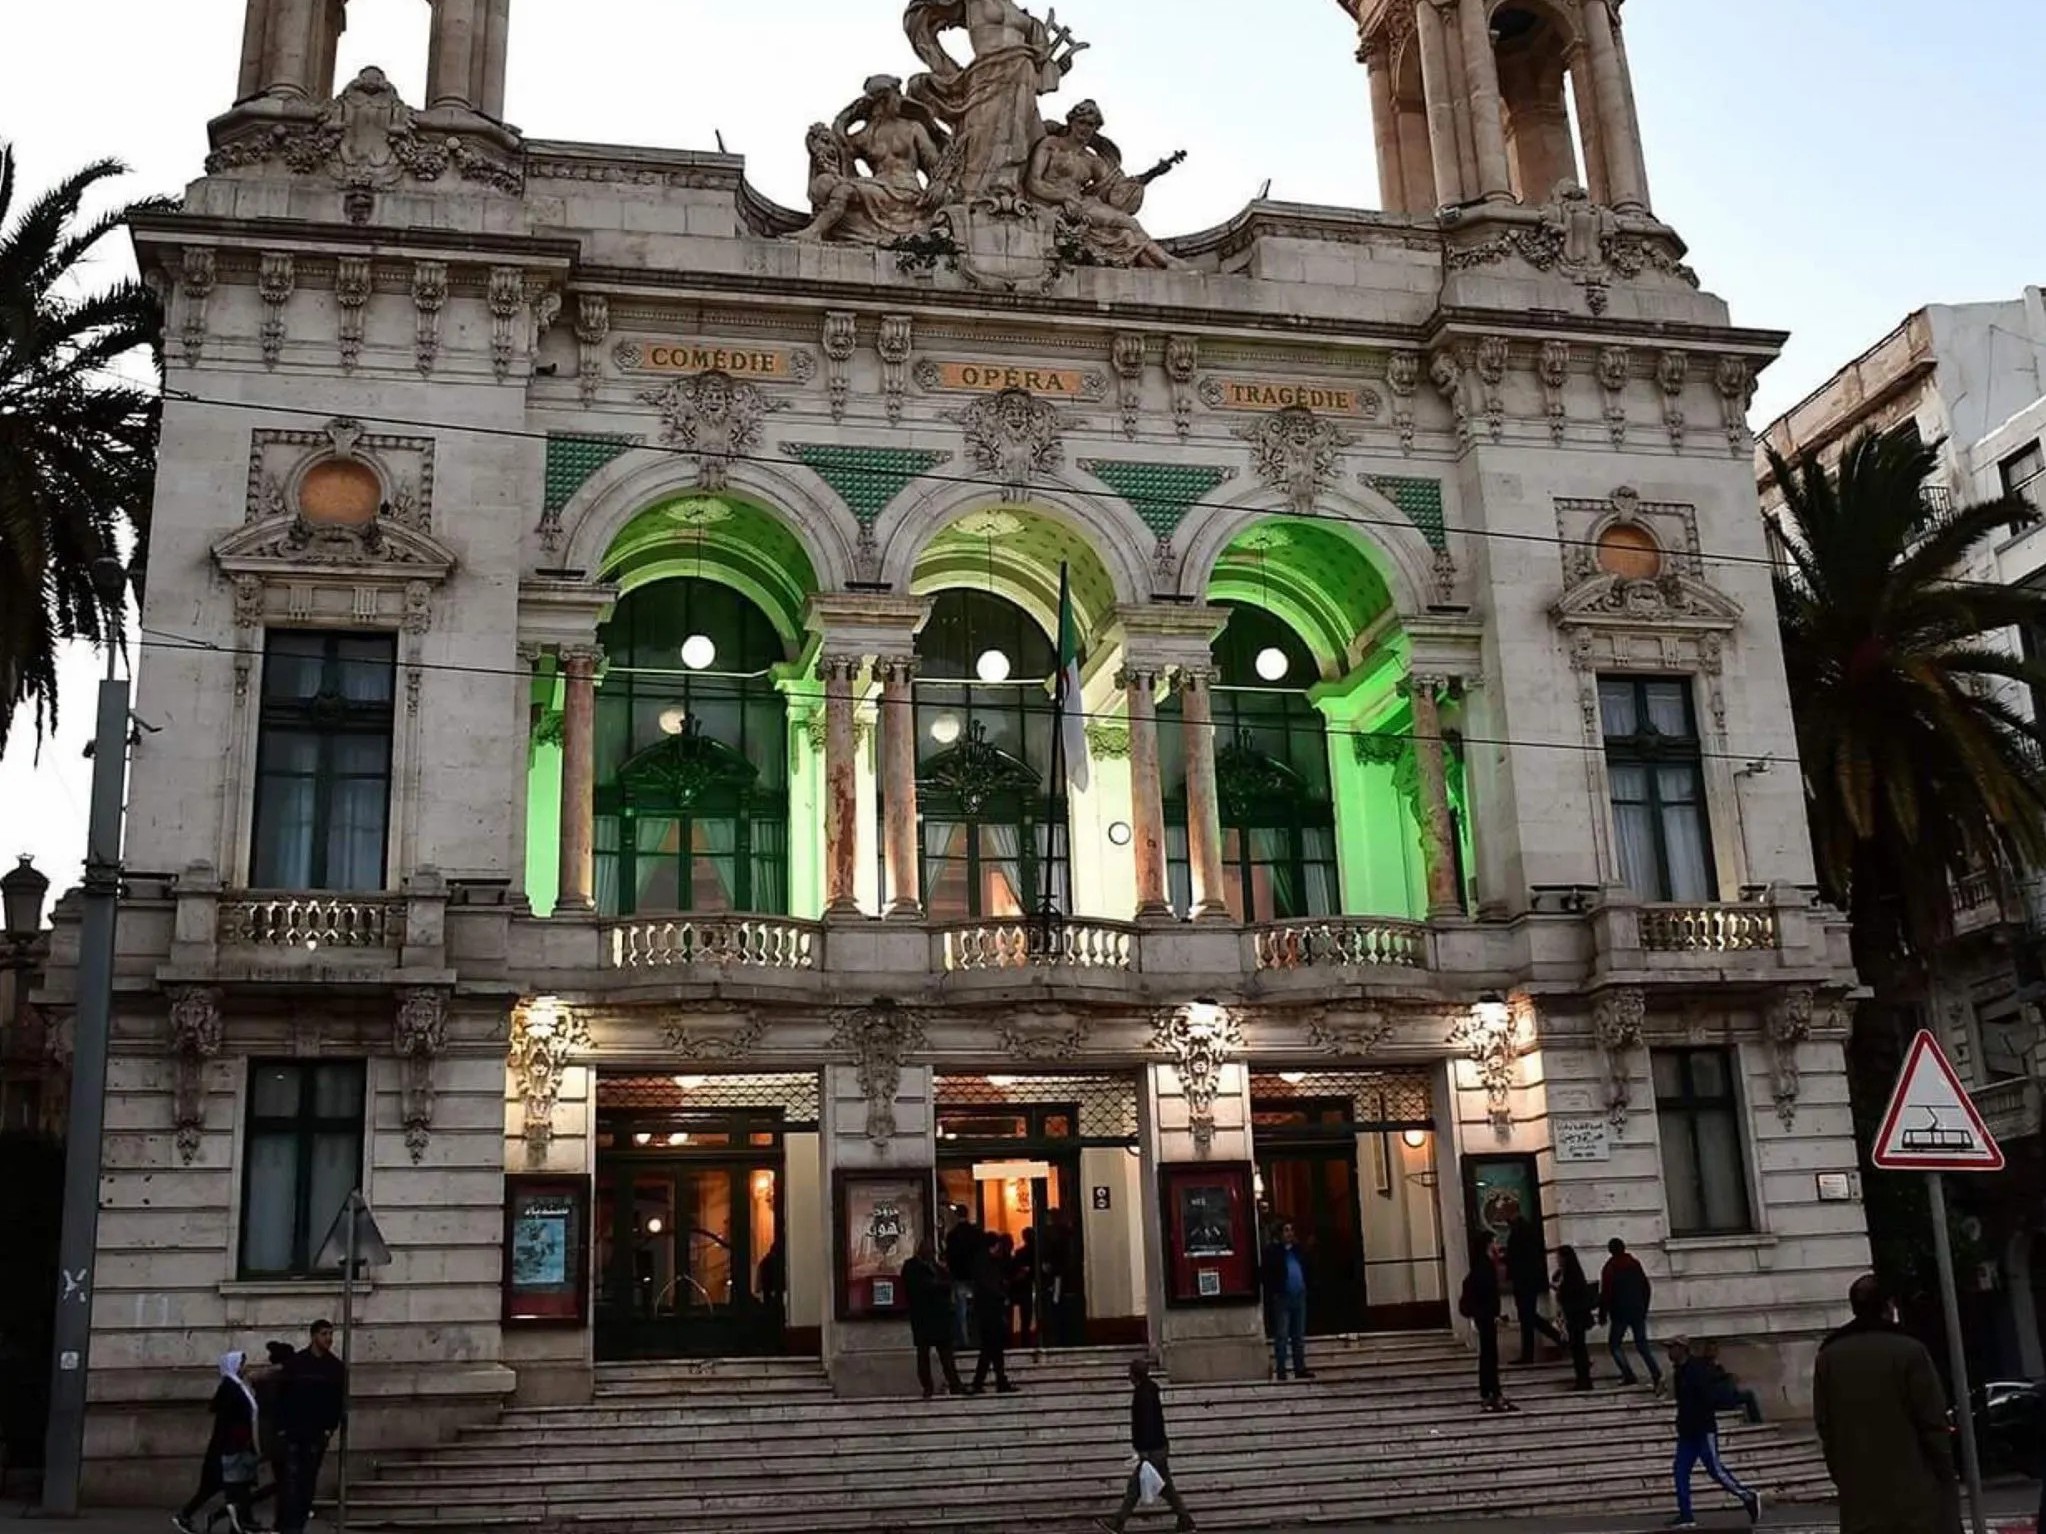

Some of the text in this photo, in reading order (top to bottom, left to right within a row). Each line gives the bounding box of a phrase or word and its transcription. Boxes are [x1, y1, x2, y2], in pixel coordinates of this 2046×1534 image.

[651, 346, 775, 372] COMÉDIE
[961, 366, 1065, 391] OPÉRA
[1231, 384, 1350, 409] TRAGÉDIE
